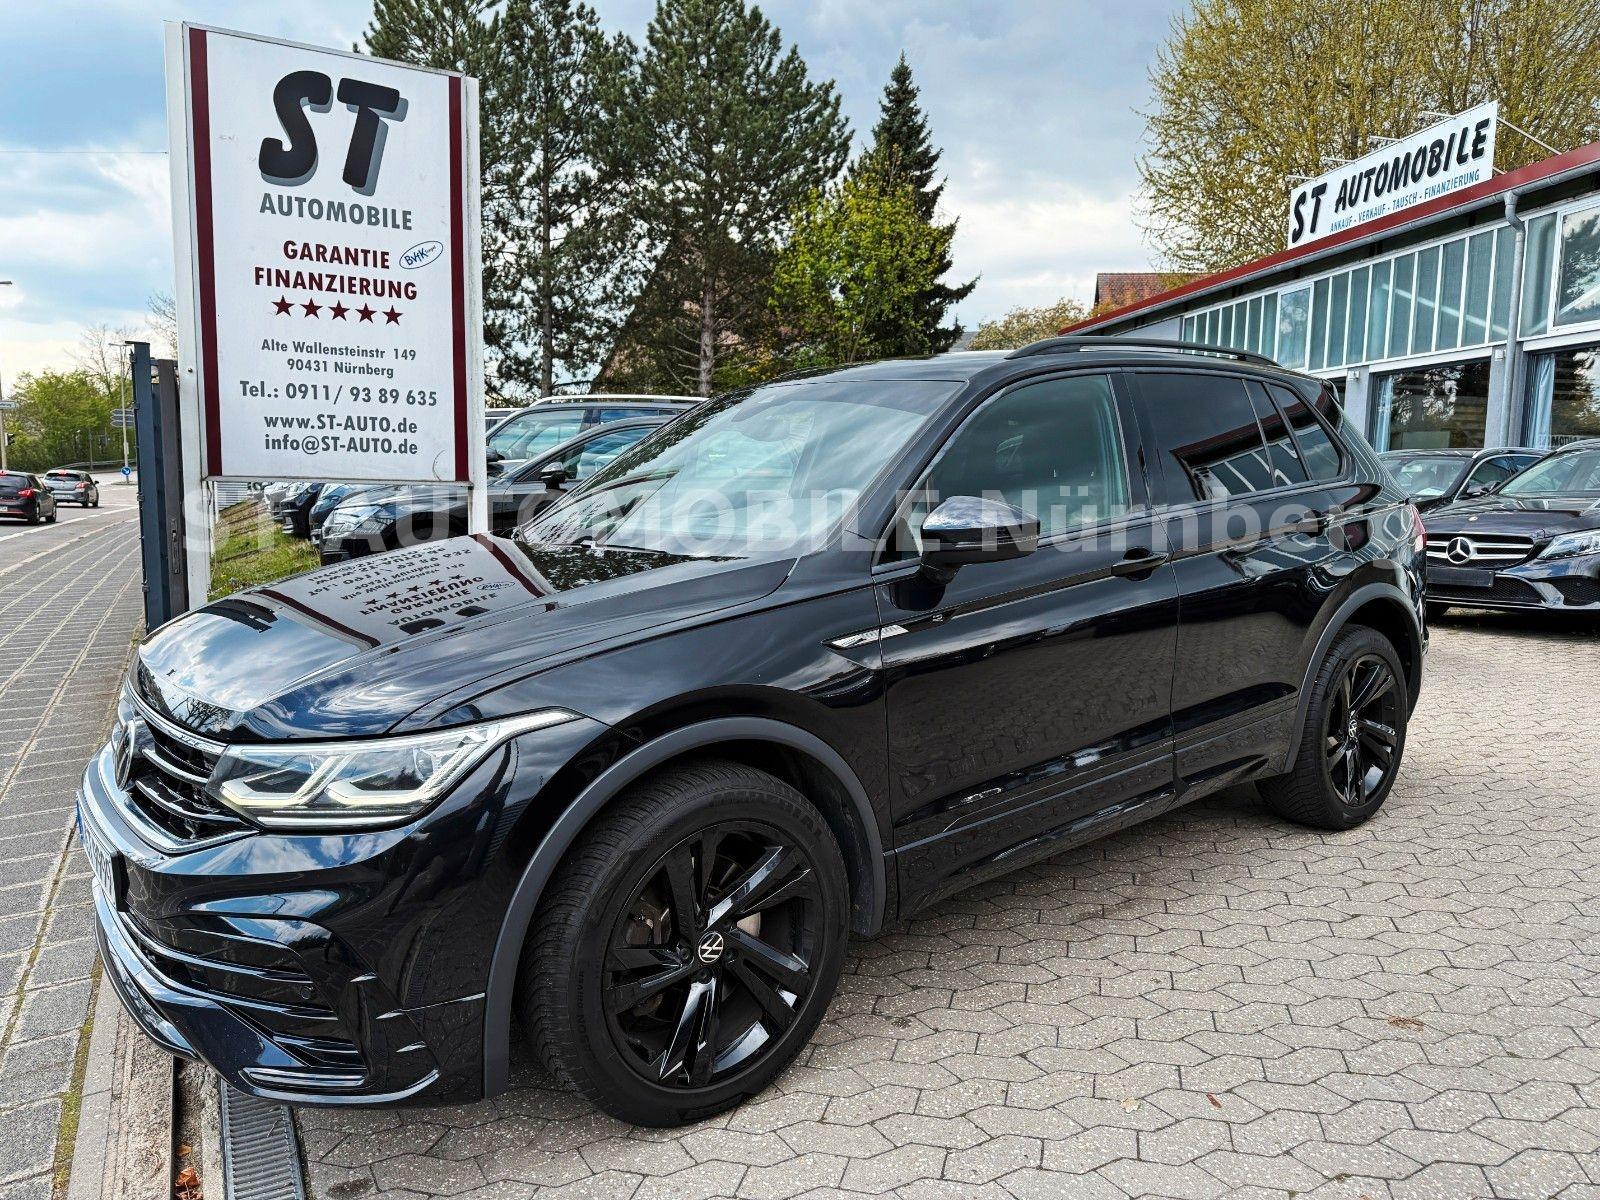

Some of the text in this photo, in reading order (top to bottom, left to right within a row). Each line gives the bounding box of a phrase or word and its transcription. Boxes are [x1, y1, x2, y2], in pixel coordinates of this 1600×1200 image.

[259, 70, 408, 196] ST
[1291, 117, 1491, 244] ST AUTOMOBILE
[259, 192, 412, 231] AUTOMOBILE
[1330, 215, 1353, 232] ANKAUF
[1358, 203, 1387, 222] VERKAUF
[1393, 191, 1418, 211] TAUSCH
[1424, 168, 1480, 200] FINANZIERUNG
[283, 240, 390, 269] GARANTIE
[255, 267, 417, 300] FINANZIERUNG
[261, 339, 416, 361] Alte Wallensteinstr 149
[287, 359, 394, 379] 90431 Nürnberg
[240, 381, 279, 399] Tel.:
[350, 387, 371, 403] 93
[379, 388, 400, 404] 89
[406, 390, 437, 406] 635
[264, 414, 418, 434] www.ST-AUTO.de
[265, 434, 418, 455] info@ST-AUTO.de
